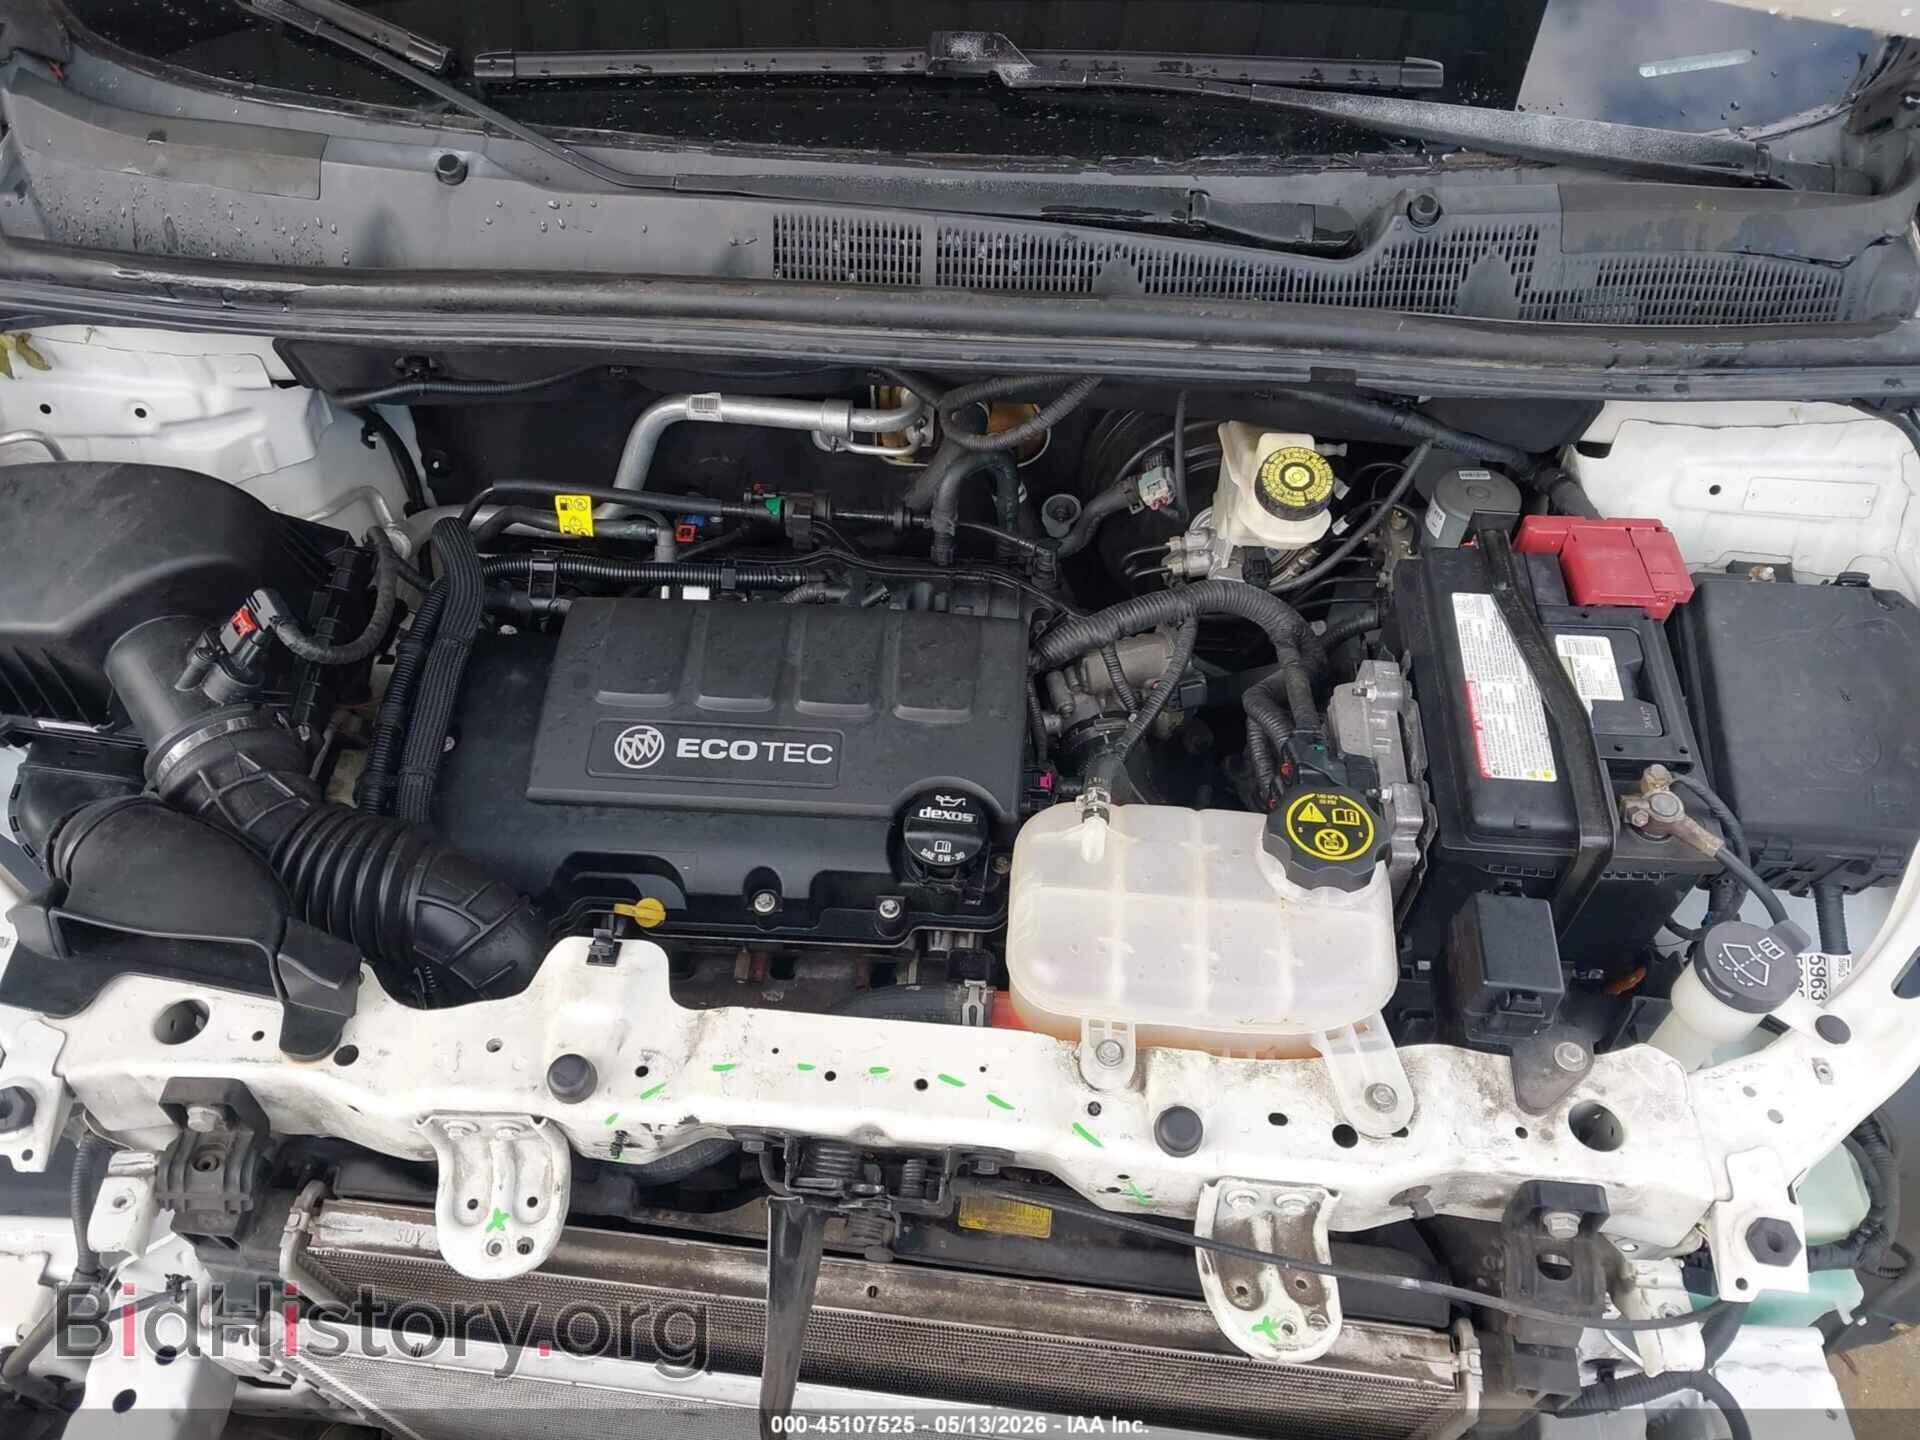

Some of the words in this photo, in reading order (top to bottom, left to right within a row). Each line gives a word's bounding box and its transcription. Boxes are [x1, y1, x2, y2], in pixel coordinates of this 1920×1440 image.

[676, 738, 834, 765] ECOTEC
[919, 806, 976, 823] dexos
[920, 848, 936, 861] SAE
[1808, 955, 1828, 1001] 5963
